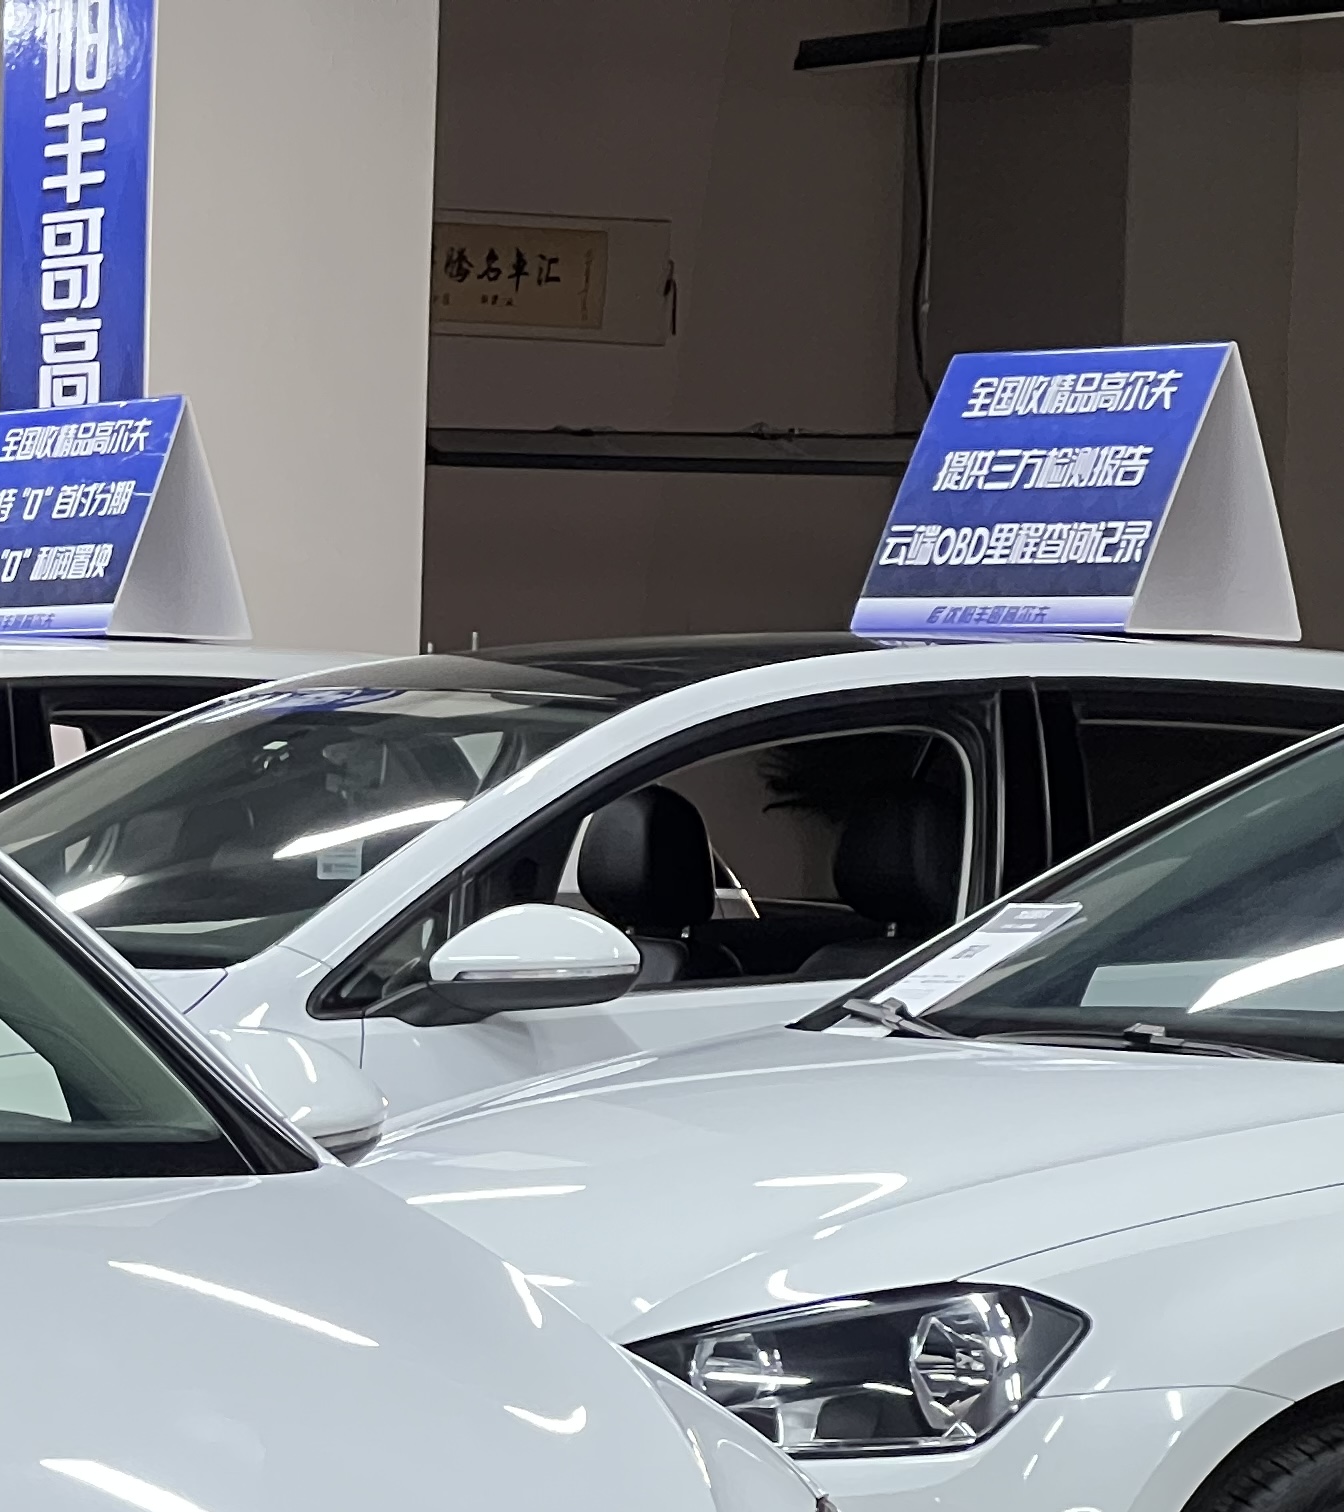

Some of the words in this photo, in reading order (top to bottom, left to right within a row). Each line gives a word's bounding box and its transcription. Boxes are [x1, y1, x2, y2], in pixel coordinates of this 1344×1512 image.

[960, 368, 1184, 419] 全国收精品高尔夫
[932, 445, 1155, 492] 提供三方检测报告
[878, 519, 1153, 566] 云端OBD里程查询记录
